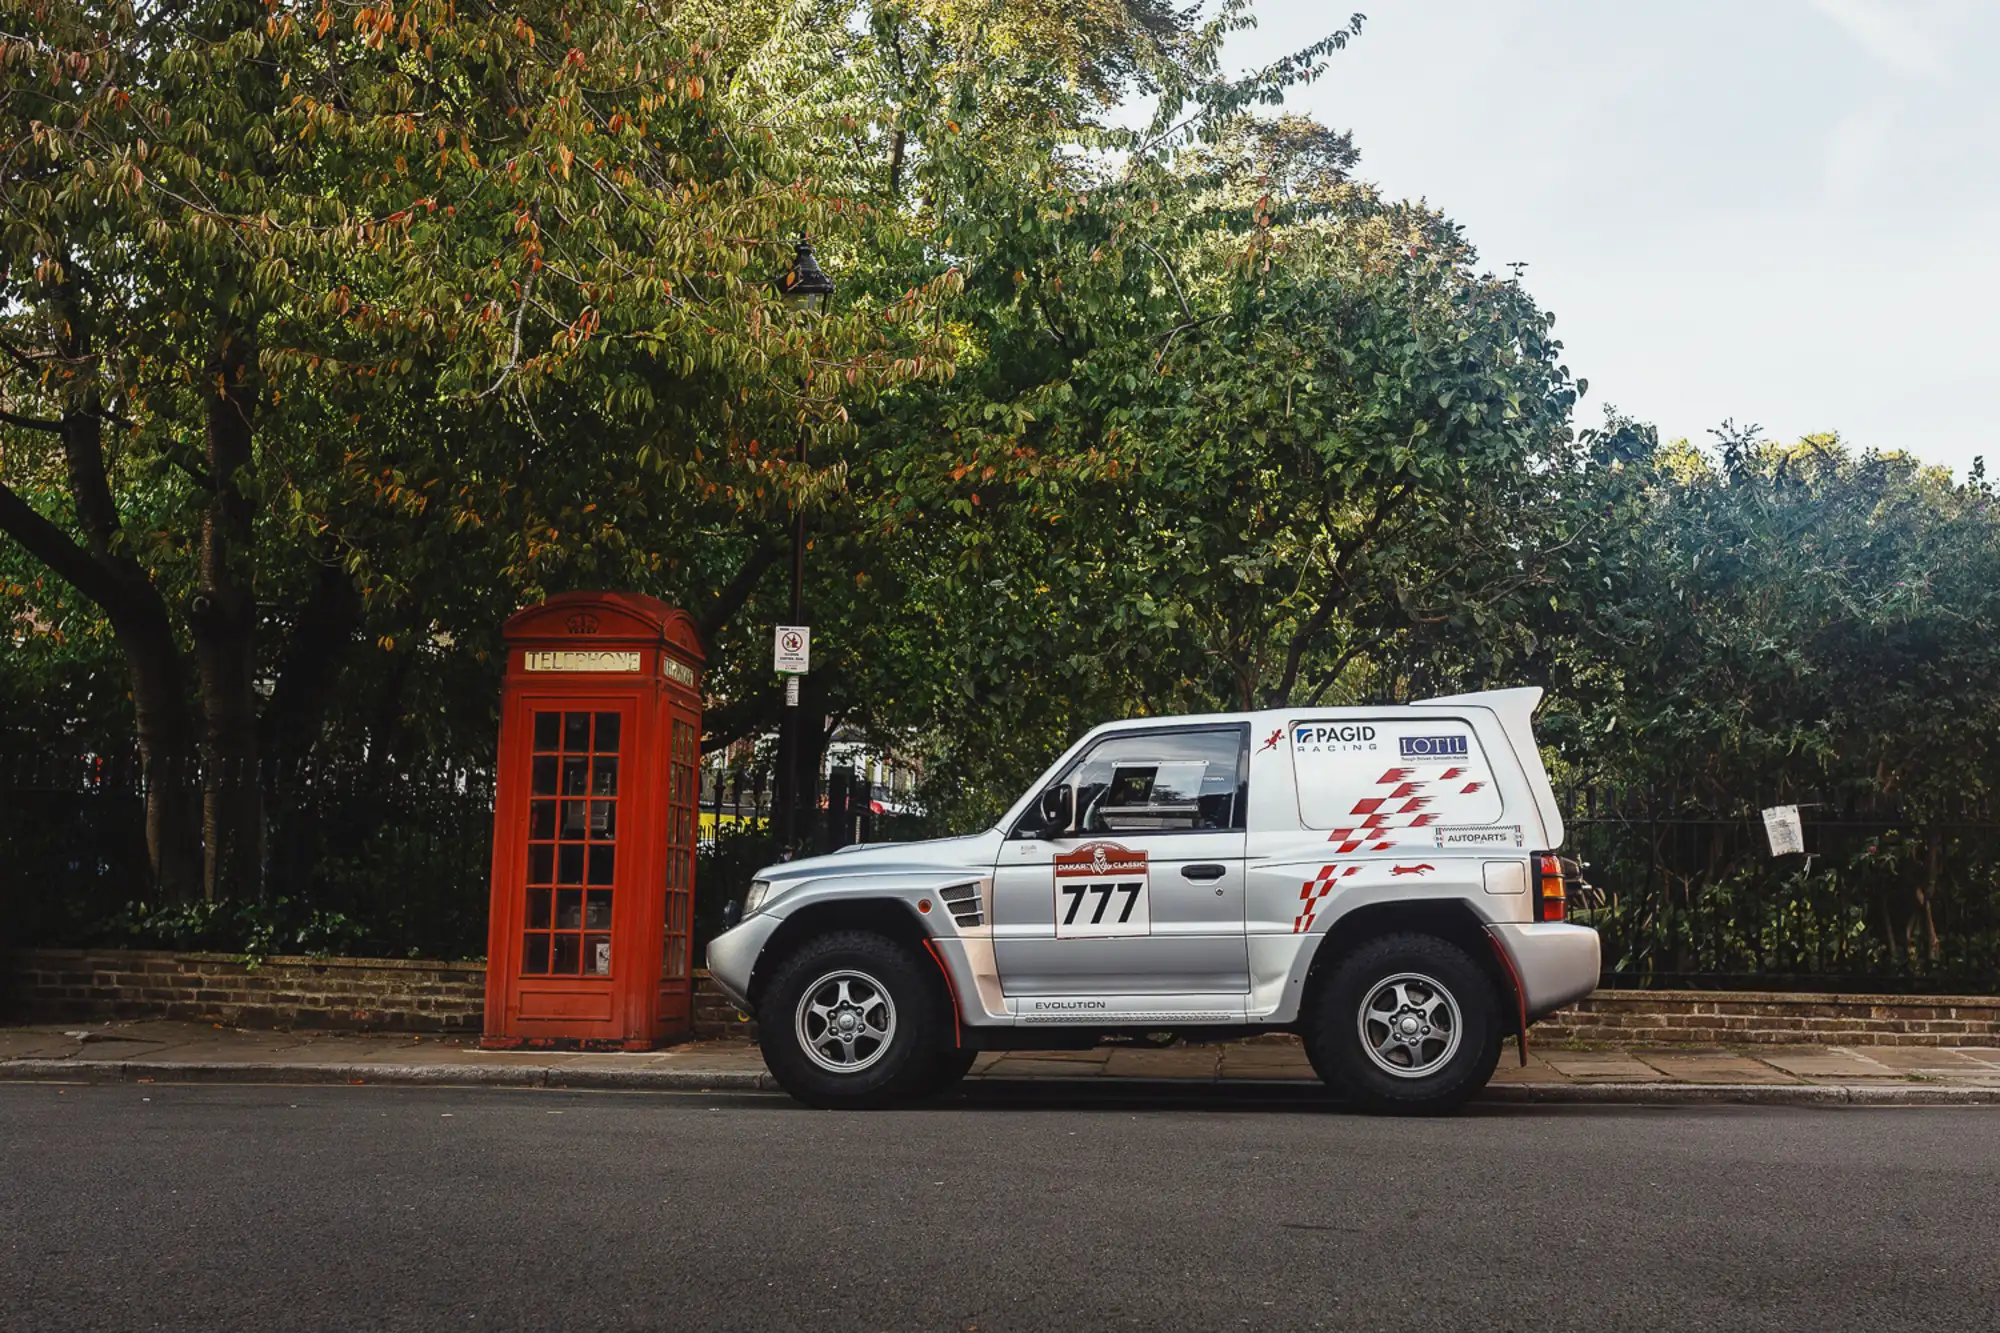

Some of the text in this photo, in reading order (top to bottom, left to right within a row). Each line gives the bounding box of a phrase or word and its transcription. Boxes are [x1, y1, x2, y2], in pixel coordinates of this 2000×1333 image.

[1316, 726, 1376, 743] PAGID
[1296, 744, 1378, 752] RACING
[1401, 737, 1467, 754] LOTIL
[1447, 833, 1507, 842] AUTOPARTS
[1058, 861, 1145, 871] DAKAR CLASSIC
[1062, 882, 1144, 926] 777
[1035, 1001, 1106, 1010] EVOLUTION
